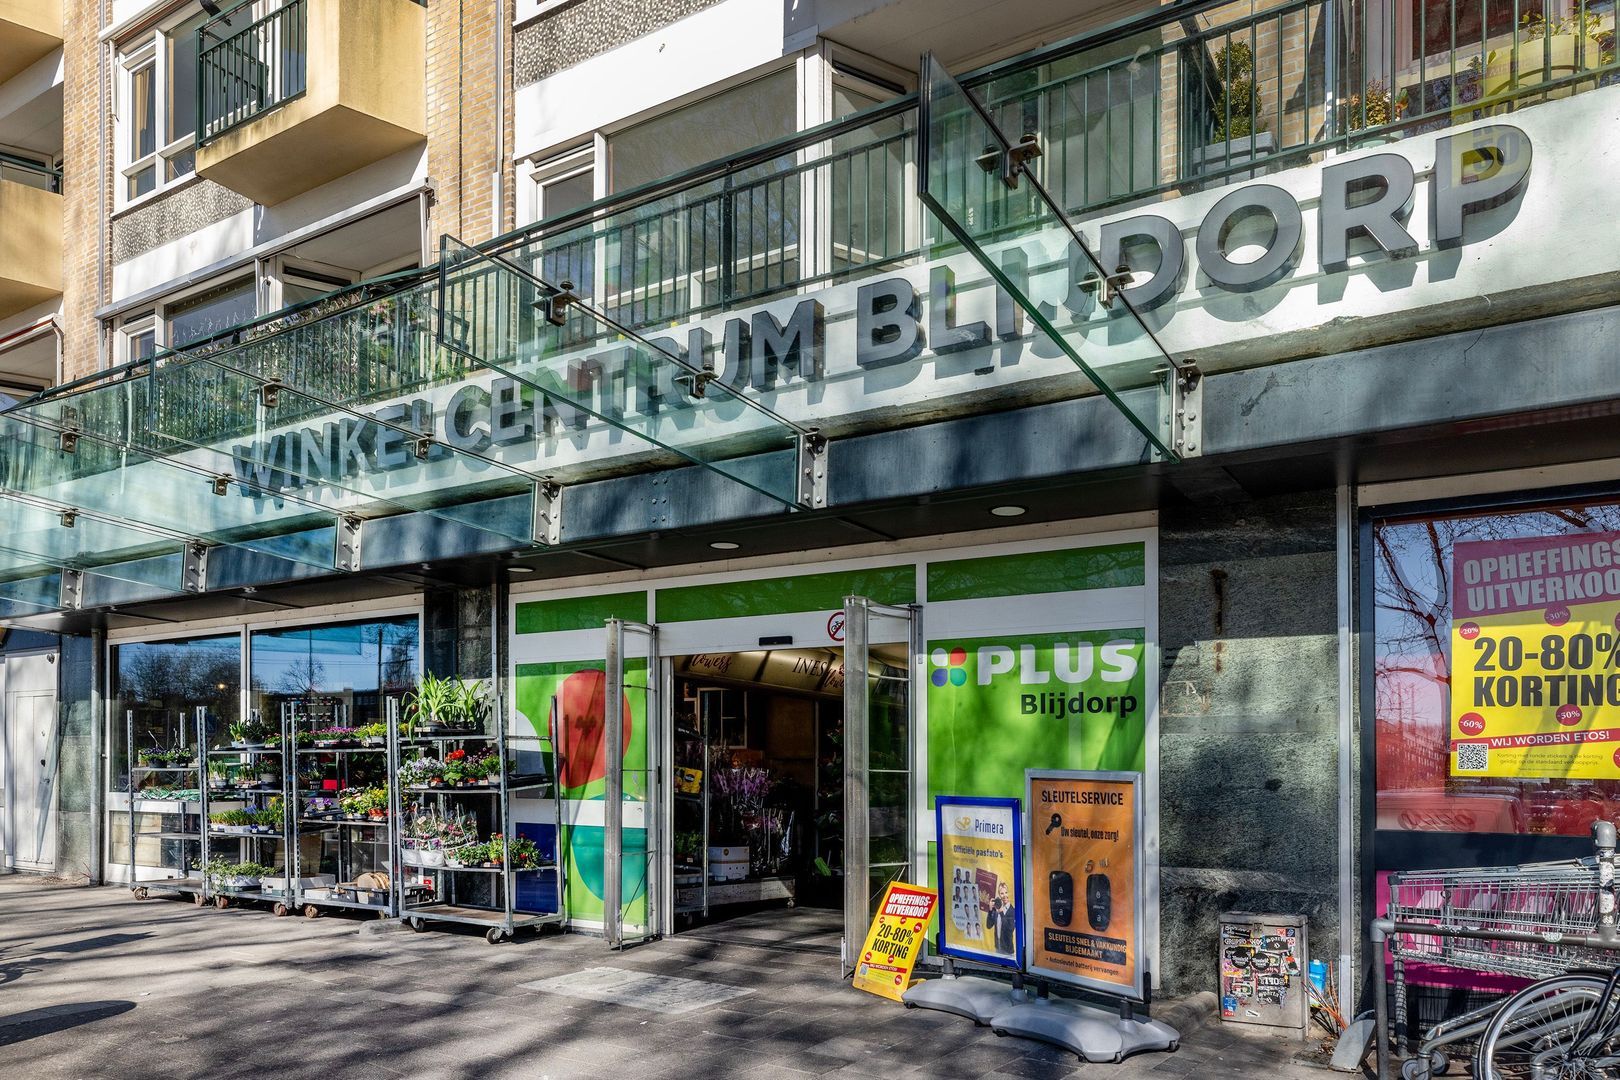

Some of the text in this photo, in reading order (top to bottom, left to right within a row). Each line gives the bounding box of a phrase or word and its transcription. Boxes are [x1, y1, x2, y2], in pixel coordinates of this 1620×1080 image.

[232, 123, 1533, 499] WINKELCENTRUM BLIJDORP
[1546, 611, 1569, 621] -30%
[1460, 626, 1479, 635] -20%
[1474, 633, 1620, 672] 20-80%
[792, 657, 828, 677] INES
[977, 638, 1138, 686] PLUS
[1474, 673, 1620, 707] KORTING
[1020, 691, 1138, 719] Blijdorp
[1557, 709, 1581, 720] -50%
[1460, 719, 1483, 730] -60%
[1491, 731, 1610, 747] WIJ WORDEN ETOS!
[1041, 790, 1124, 806] SLEUTELSERVICE
[975, 819, 1004, 835] Primera
[888, 893, 932, 907] OPHEFFINGS-
[885, 903, 929, 918] UITVERKOOP
[877, 923, 914, 945] 20-80%
[1048, 932, 1076, 944] SLEUTELS
[1076, 937, 1091, 947] SNEL
[1091, 939, 1096, 948] &
[871, 938, 910, 959] KORTING
